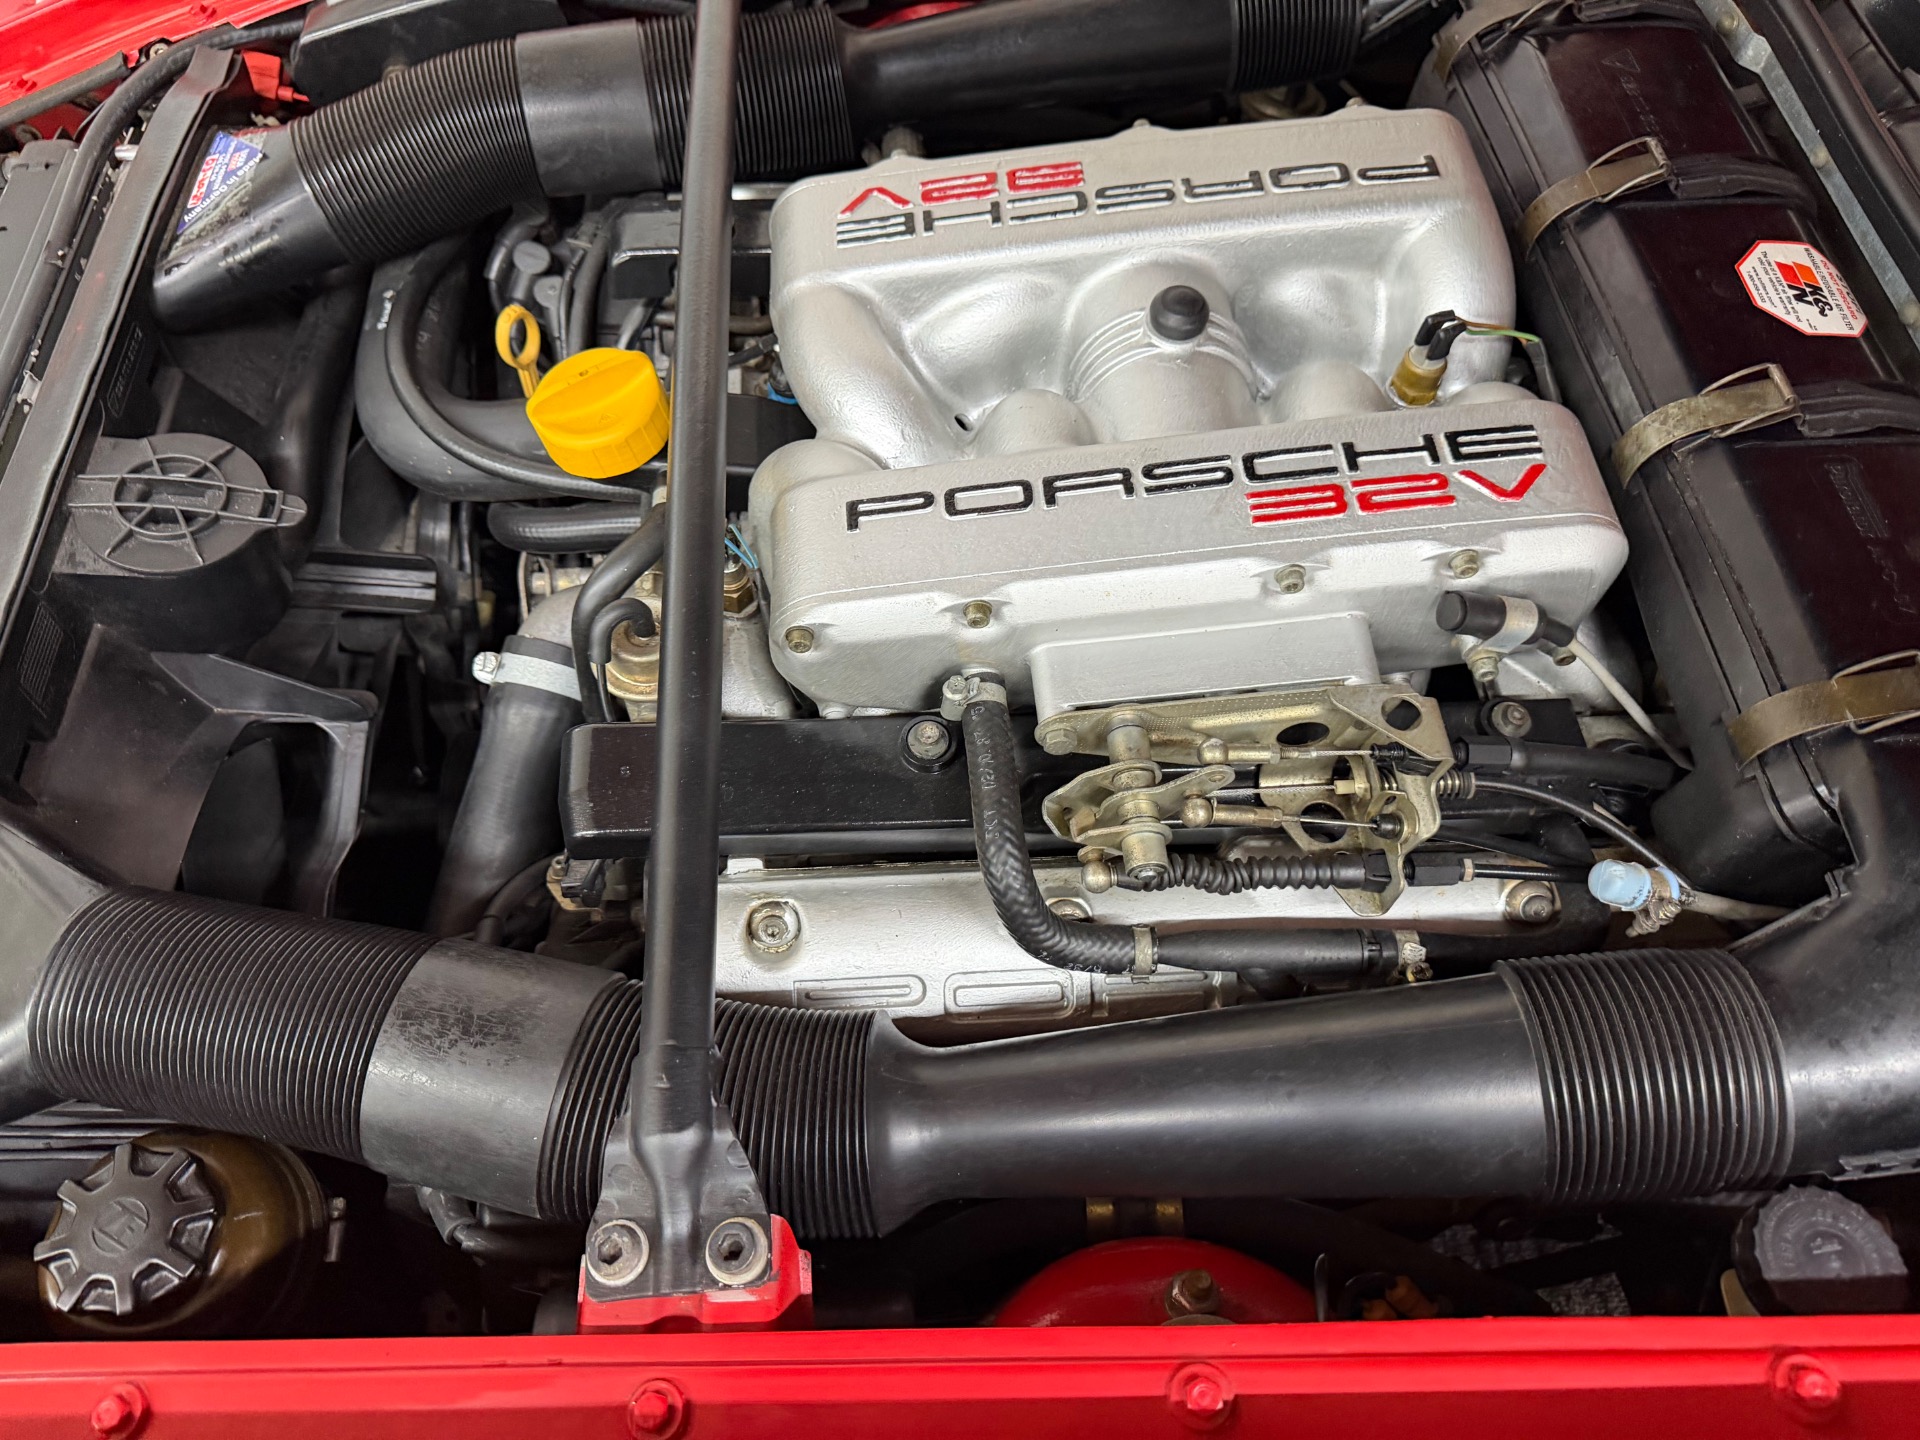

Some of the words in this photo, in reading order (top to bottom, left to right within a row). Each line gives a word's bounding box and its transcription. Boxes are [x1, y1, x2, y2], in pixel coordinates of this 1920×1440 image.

[226, 175, 239, 185] in
[236, 152, 263, 176] Made
[838, 161, 1085, 218] 32V
[184, 184, 228, 223] Germany
[836, 155, 1442, 248] PORSCHE
[1820, 260, 1829, 269] DO
[1826, 272, 1838, 285] NOT
[1836, 288, 1858, 319] DISCARD
[1834, 303, 1843, 311] AIR
[1839, 313, 1854, 330] FILTER
[845, 425, 1545, 533] PORSCHE
[1244, 463, 1546, 525] 32V
